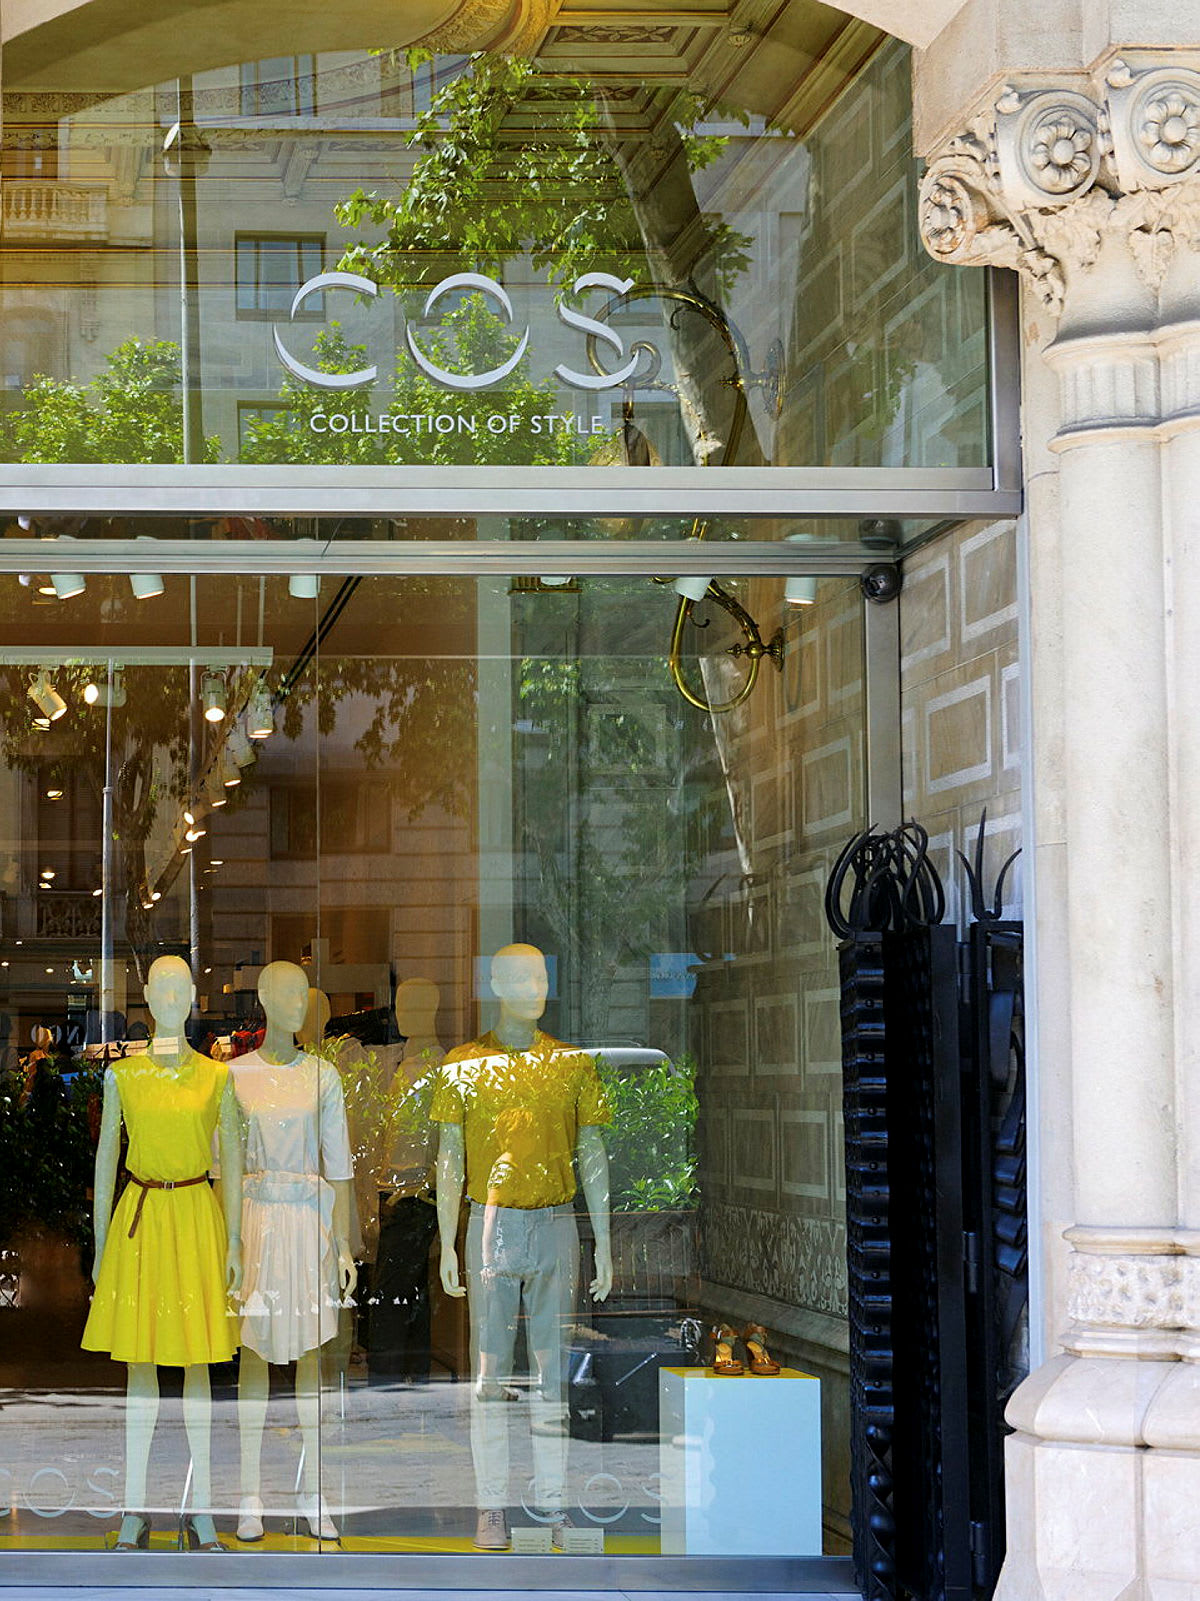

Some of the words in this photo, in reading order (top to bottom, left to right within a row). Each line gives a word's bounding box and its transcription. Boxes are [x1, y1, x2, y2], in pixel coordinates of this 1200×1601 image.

[272, 272, 640, 389] COS
[309, 414, 476, 434] COLLECTION
[487, 414, 520, 434] OF
[530, 415, 602, 435] STYLE
[520, 1473, 675, 1524] COS
